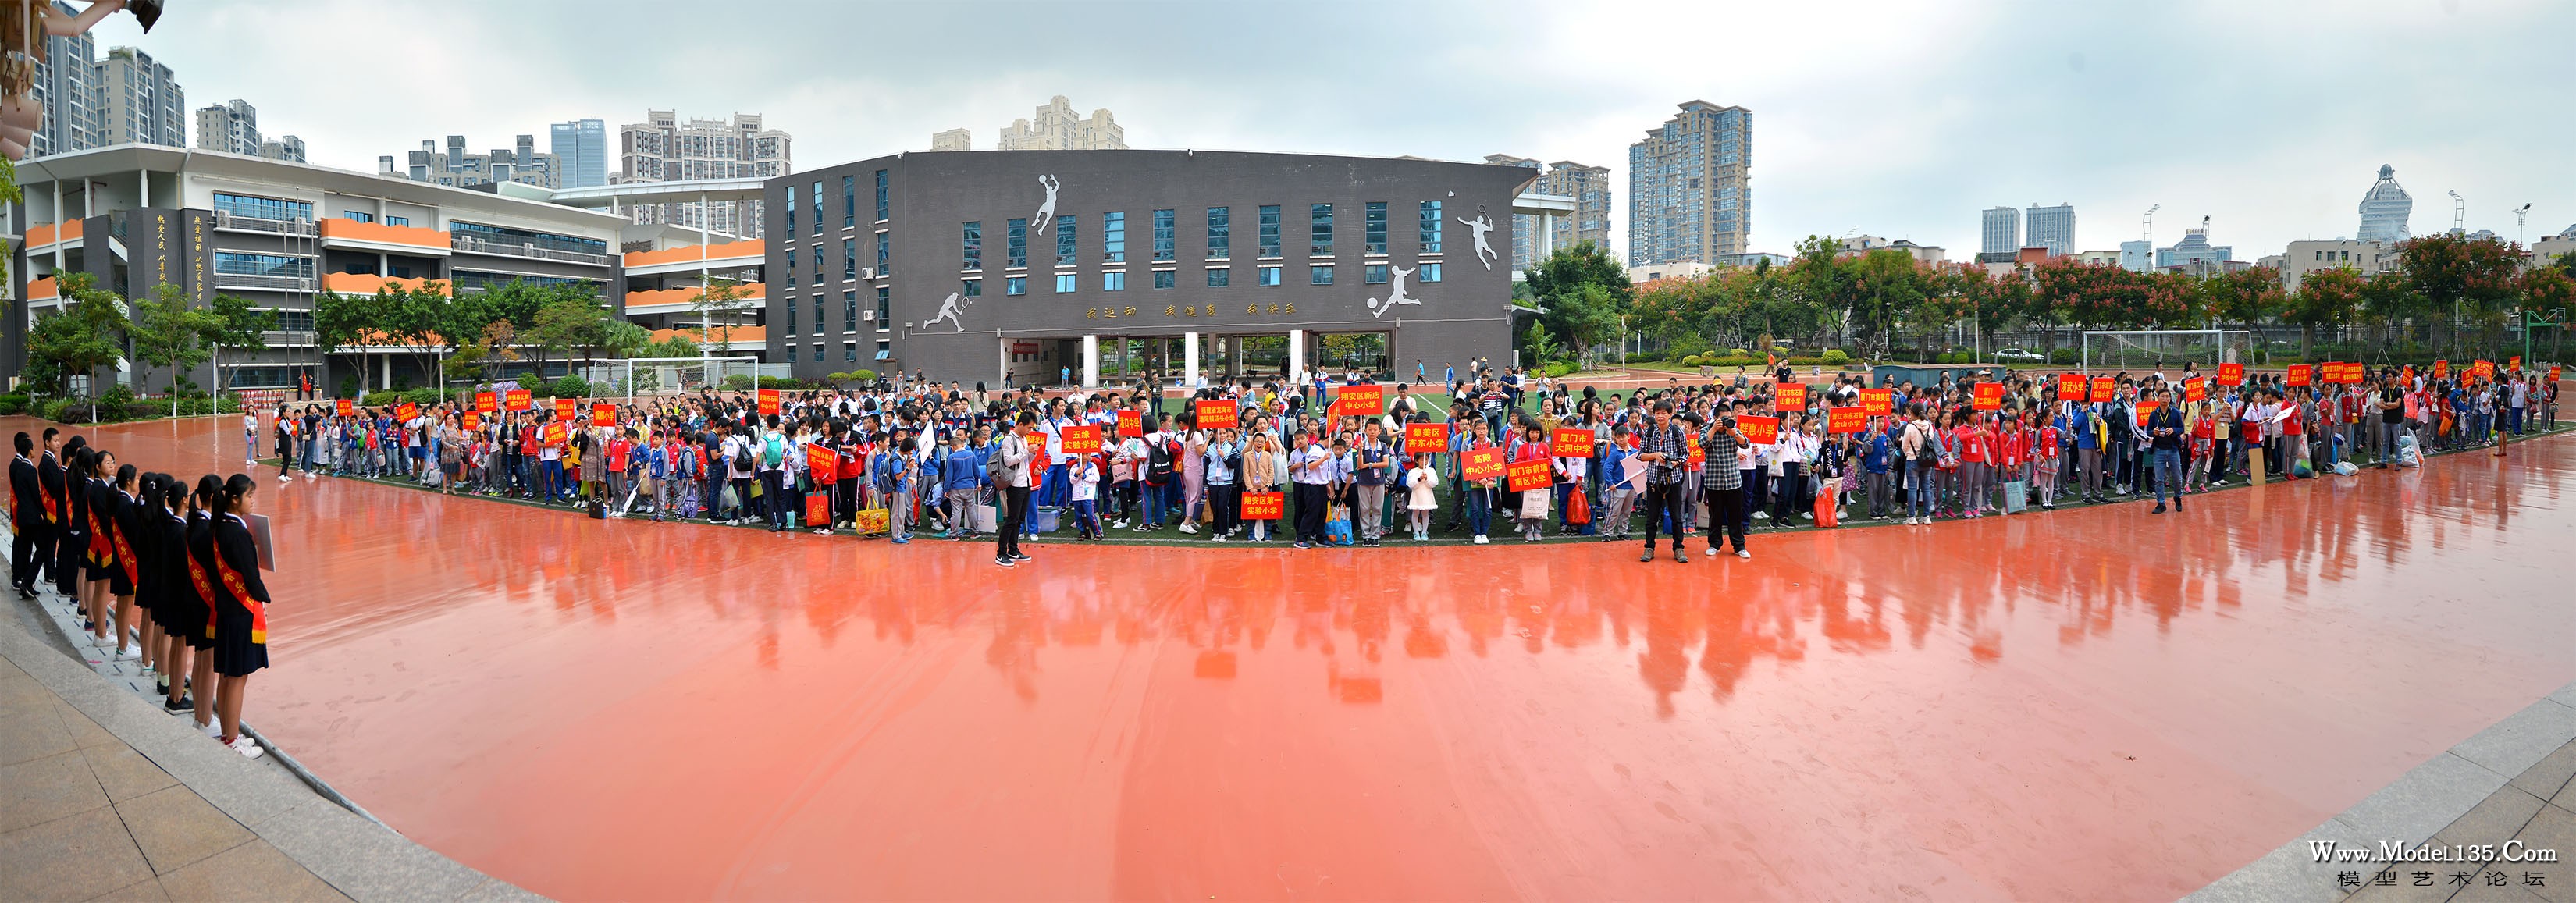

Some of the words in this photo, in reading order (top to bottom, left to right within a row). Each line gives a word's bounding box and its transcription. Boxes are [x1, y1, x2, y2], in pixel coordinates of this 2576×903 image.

[1086, 305, 1137, 319] 我运动
[1165, 304, 1216, 317] 我健康
[1247, 302, 1297, 316] 我快乐
[1984, 387, 1993, 396] 厦门
[2061, 380, 2084, 393] 演武小学
[1340, 391, 1380, 400] 翔安区新店
[2094, 390, 2110, 399] 实验小学
[2188, 389, 2203, 399] 中心小学
[1345, 400, 1377, 410] 中心小学
[1779, 396, 1802, 406] 山前小学
[1974, 396, 2001, 406] 第二实验小学
[760, 402, 777, 411] 中心小学
[1201, 405, 1233, 414] 福建省龙海市
[1119, 416, 1140, 430] 灌口中学
[1834, 420, 1861, 428] 金山小学
[1072, 430, 1091, 439] 五缘
[1413, 428, 1440, 438] 集美区
[1739, 422, 1774, 438] 群惠小学
[1407, 438, 1444, 448] 杏东小学
[1560, 433, 1588, 443] 厦门市
[1063, 440, 1099, 450] 实验学校
[1555, 444, 1592, 453] 大同中学
[1472, 453, 1492, 464] 高殿
[1465, 462, 1503, 475] 中心小学
[1509, 463, 1548, 477] 厦门市前埔
[1514, 475, 1546, 487] 南区小学
[1244, 496, 1282, 505] 翔安区第一
[1247, 506, 1278, 515] 实验小学
